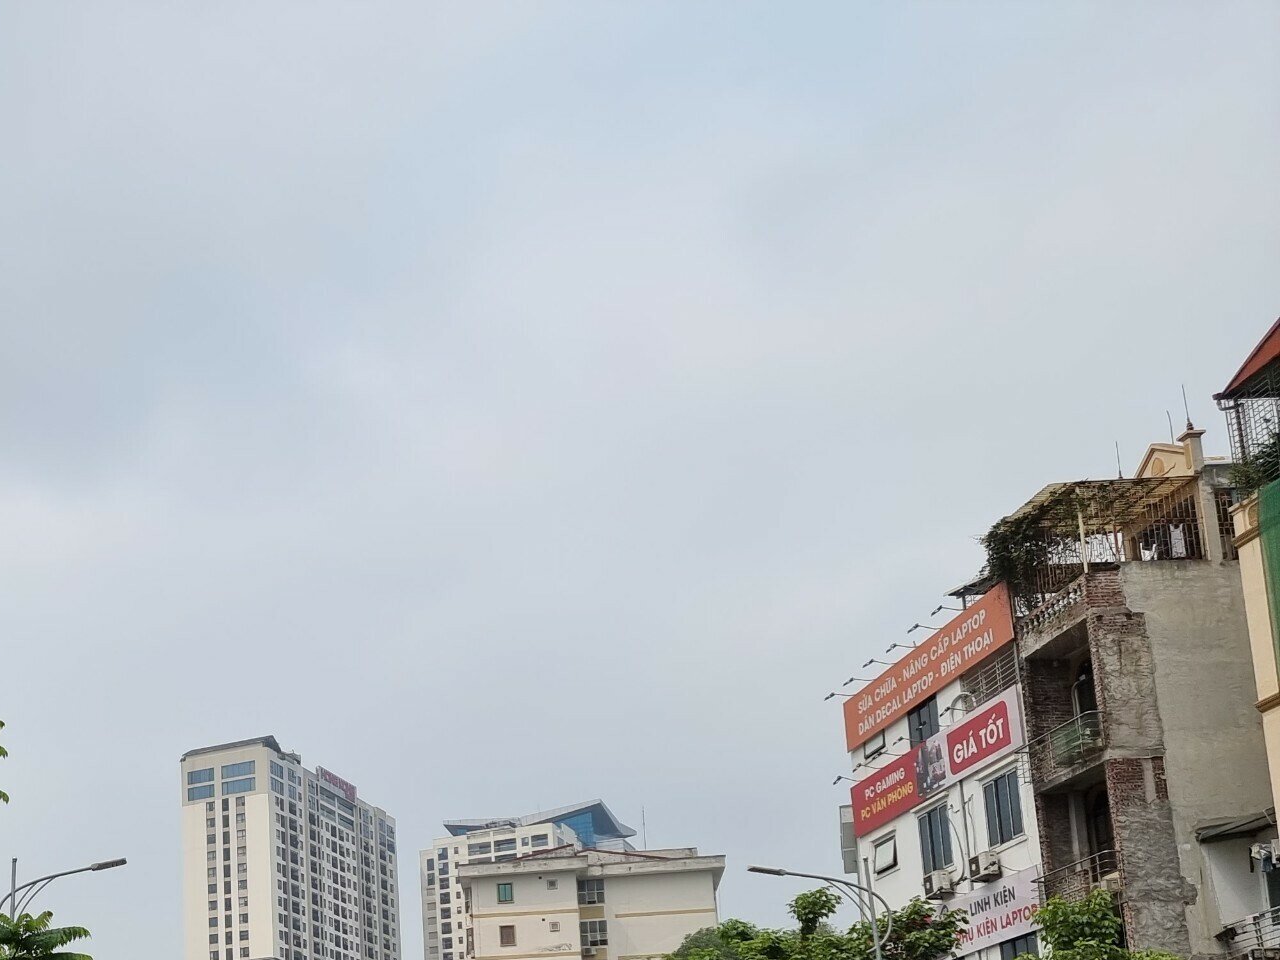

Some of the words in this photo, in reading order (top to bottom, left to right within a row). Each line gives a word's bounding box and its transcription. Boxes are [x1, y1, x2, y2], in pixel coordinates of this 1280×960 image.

[858, 694, 873, 715] SỬA
[874, 676, 898, 702] CHỮA
[903, 655, 929, 681] NÂNG
[930, 634, 949, 661] CẤP
[951, 609, 986, 645] LAPTOP
[858, 716, 875, 736] DÁN
[876, 699, 901, 724] DECAL
[903, 674, 934, 703] LAPTOP
[940, 654, 961, 677] ĐIỆN
[963, 628, 994, 661] THOẠI
[953, 731, 978, 764] GIÁ
[979, 714, 1004, 749] TỐT
[861, 807, 871, 820] PC
[871, 796, 887, 816] VĂN
[887, 781, 914, 808] PHÒNG
[864, 785, 875, 800] PC
[875, 768, 905, 793] GAMING
[969, 896, 991, 916] LINH
[993, 885, 1016, 908] KIỆN
[976, 917, 998, 938] KIỆN
